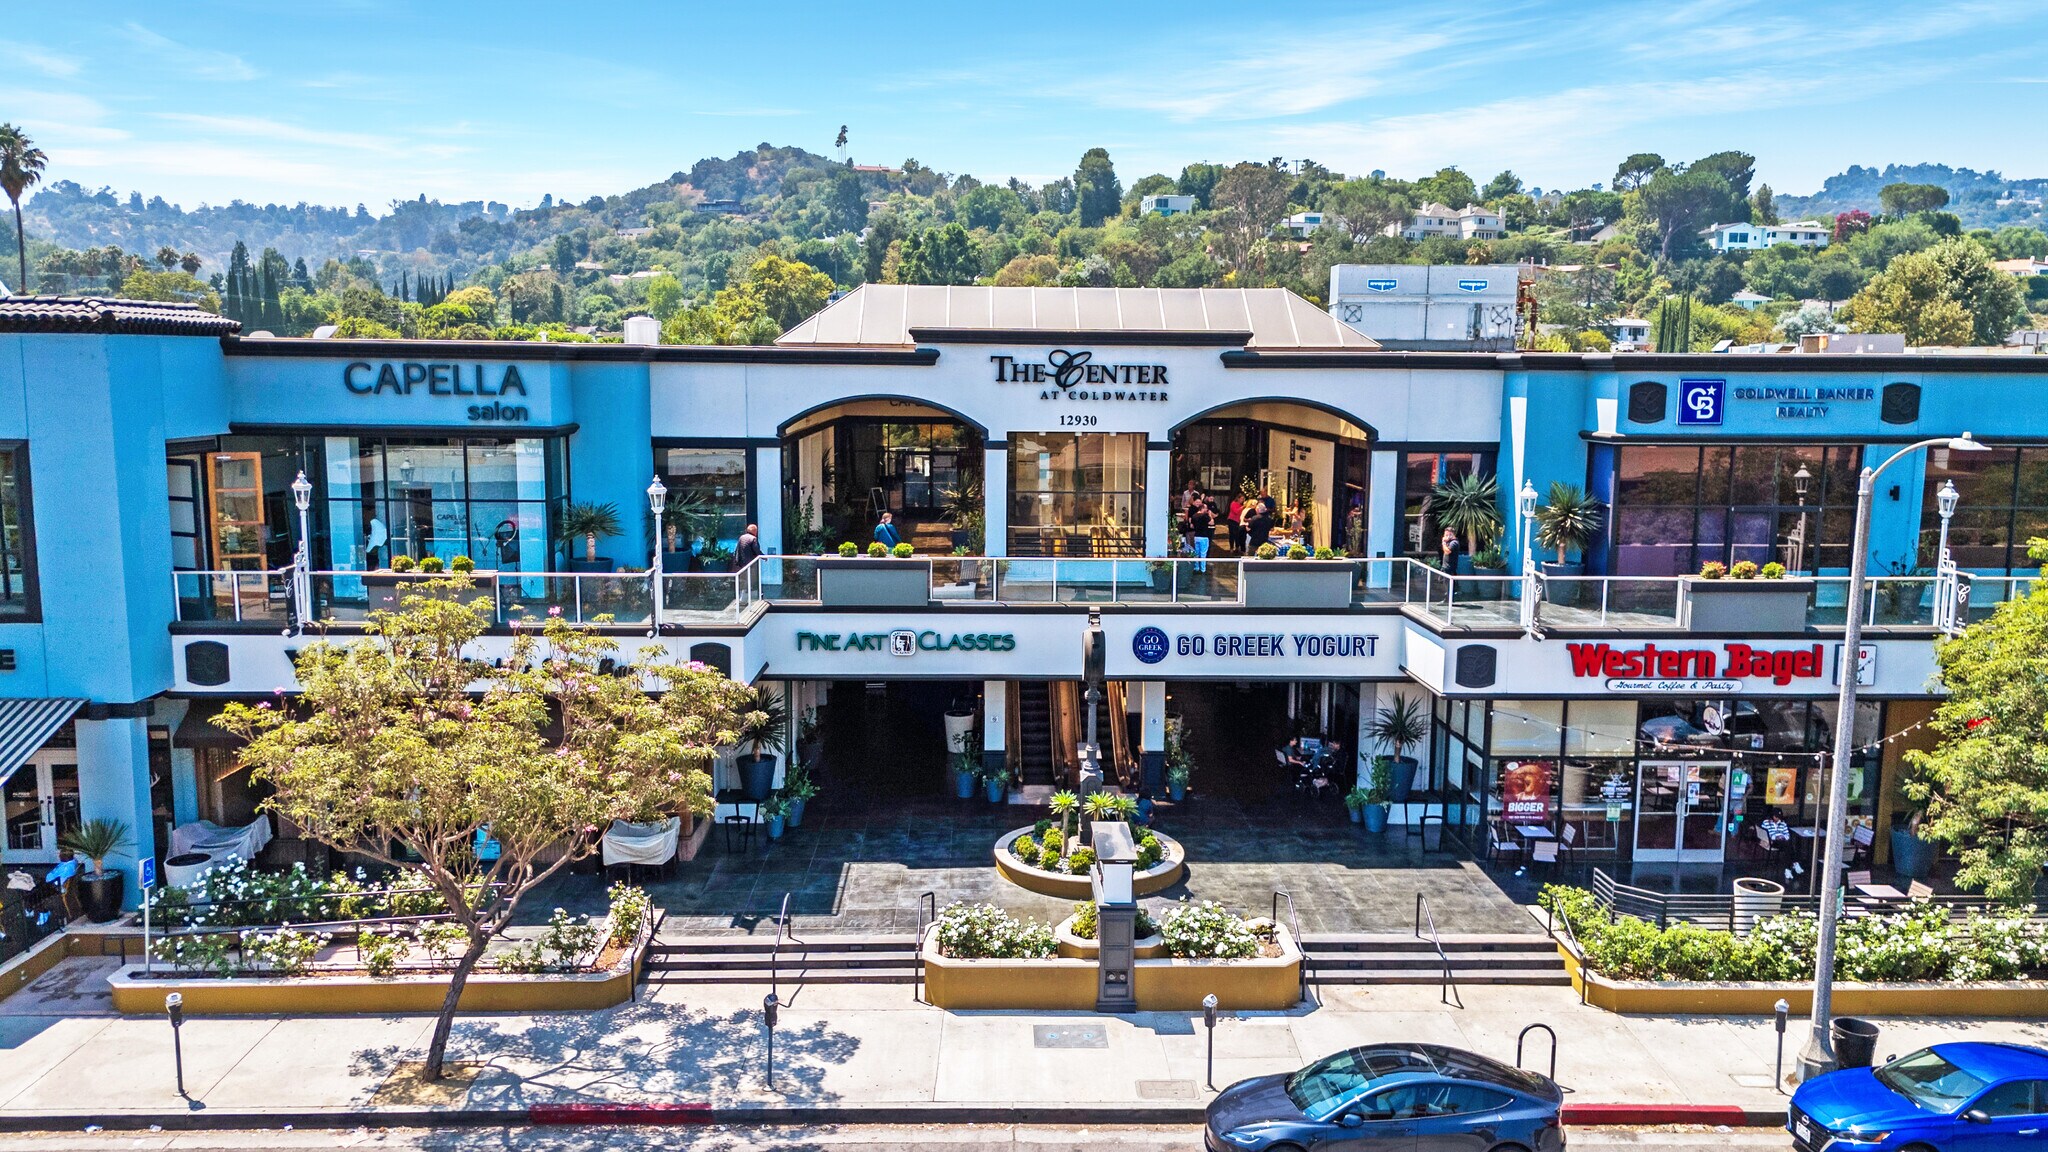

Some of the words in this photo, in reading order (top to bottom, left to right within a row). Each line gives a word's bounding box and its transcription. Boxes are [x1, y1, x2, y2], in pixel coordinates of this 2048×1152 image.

[990, 355, 1046, 383] THE
[1045, 349, 1169, 391] CENTER
[343, 362, 527, 396] CAPELLA
[1040, 391, 1060, 400] AT
[1068, 391, 1169, 402] COLDWATER
[1734, 387, 1811, 400] COLDWELL
[1815, 387, 1874, 401] BANKER
[467, 401, 529, 421] salon
[1776, 406, 1829, 418] REALTY
[1059, 415, 1098, 426] 12930
[796, 632, 842, 652] FINE
[844, 632, 889, 652] ART
[918, 630, 1016, 652] CLASSES
[1143, 635, 1159, 644] GO
[1176, 634, 1206, 657] GO
[1213, 634, 1285, 657] GREEK
[1292, 634, 1380, 657] YOGURT
[1566, 643, 1717, 678] Western
[1722, 643, 1824, 686] Bagel
[1657, 680, 1686, 692] Coffee
[1702, 680, 1735, 692] Pastry
[1508, 802, 1544, 812] BIGGER
